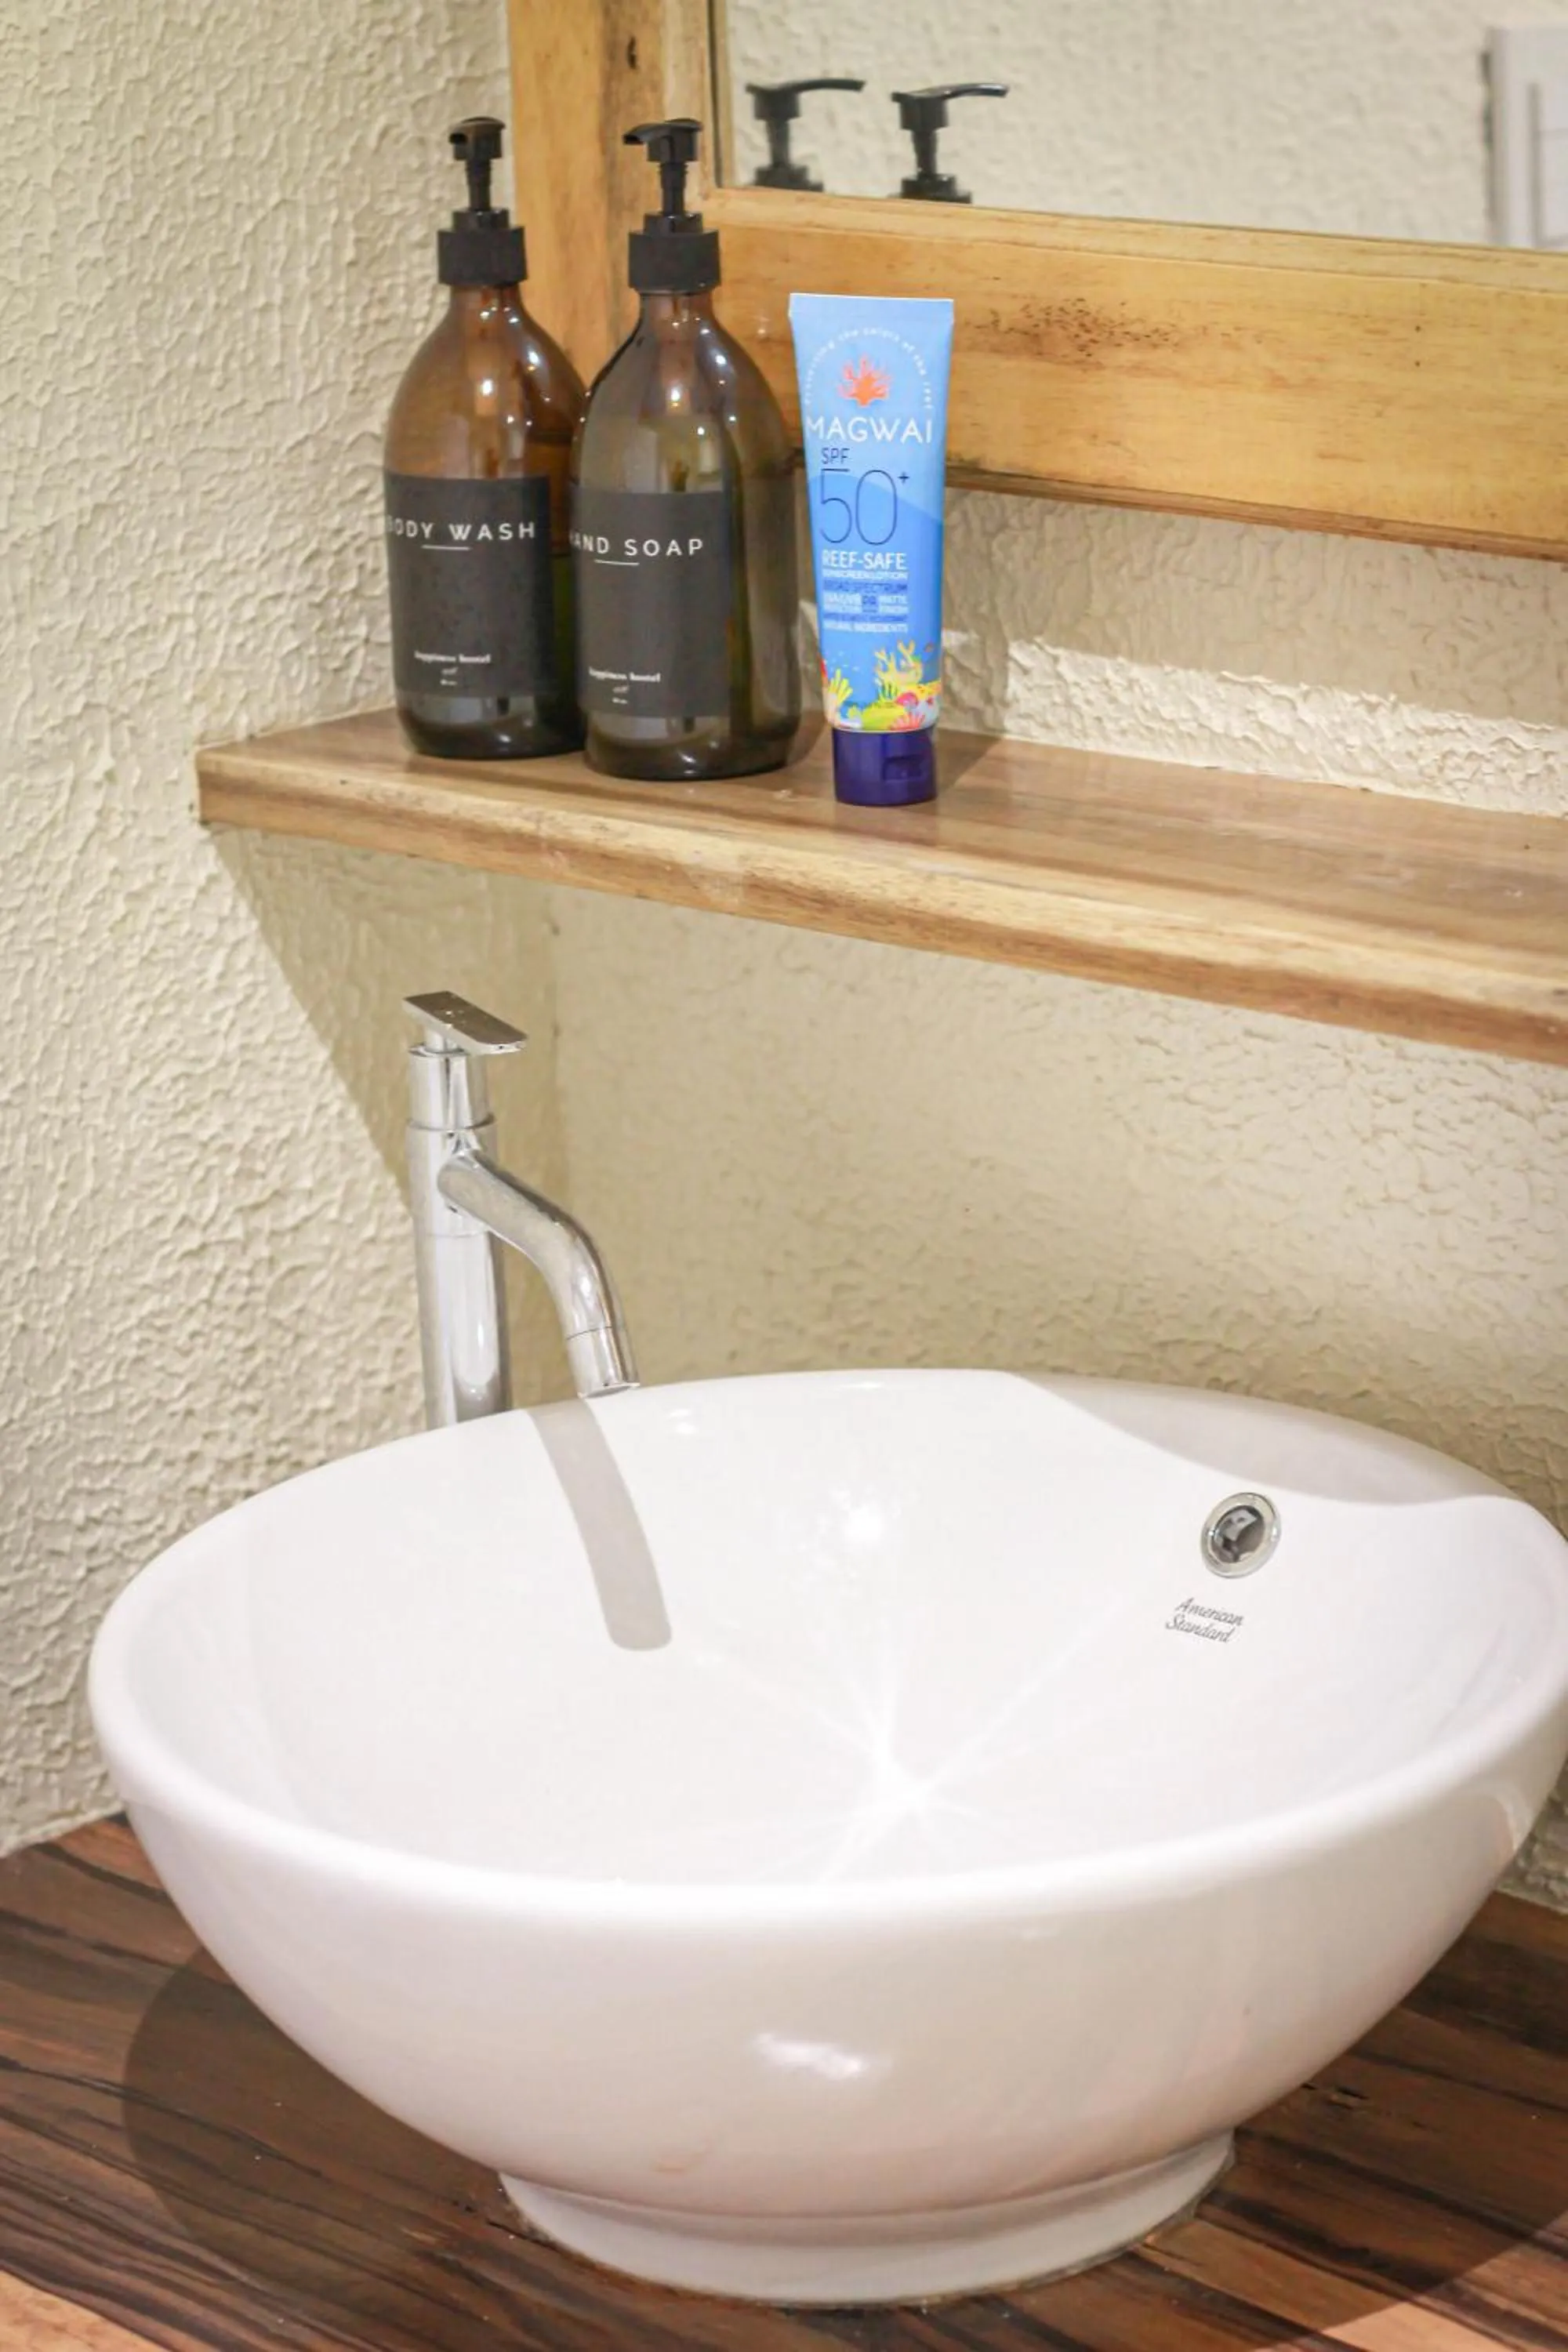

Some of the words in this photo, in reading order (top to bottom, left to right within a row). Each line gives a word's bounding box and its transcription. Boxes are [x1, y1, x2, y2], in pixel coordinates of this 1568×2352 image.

[807, 416, 932, 444] MAGWAI
[821, 448, 850, 465] SPF
[448, 522, 535, 541] WASH
[624, 538, 703, 557] SOAP
[1176, 1597, 1245, 1627] American
[1165, 1613, 1236, 1643] Standard
